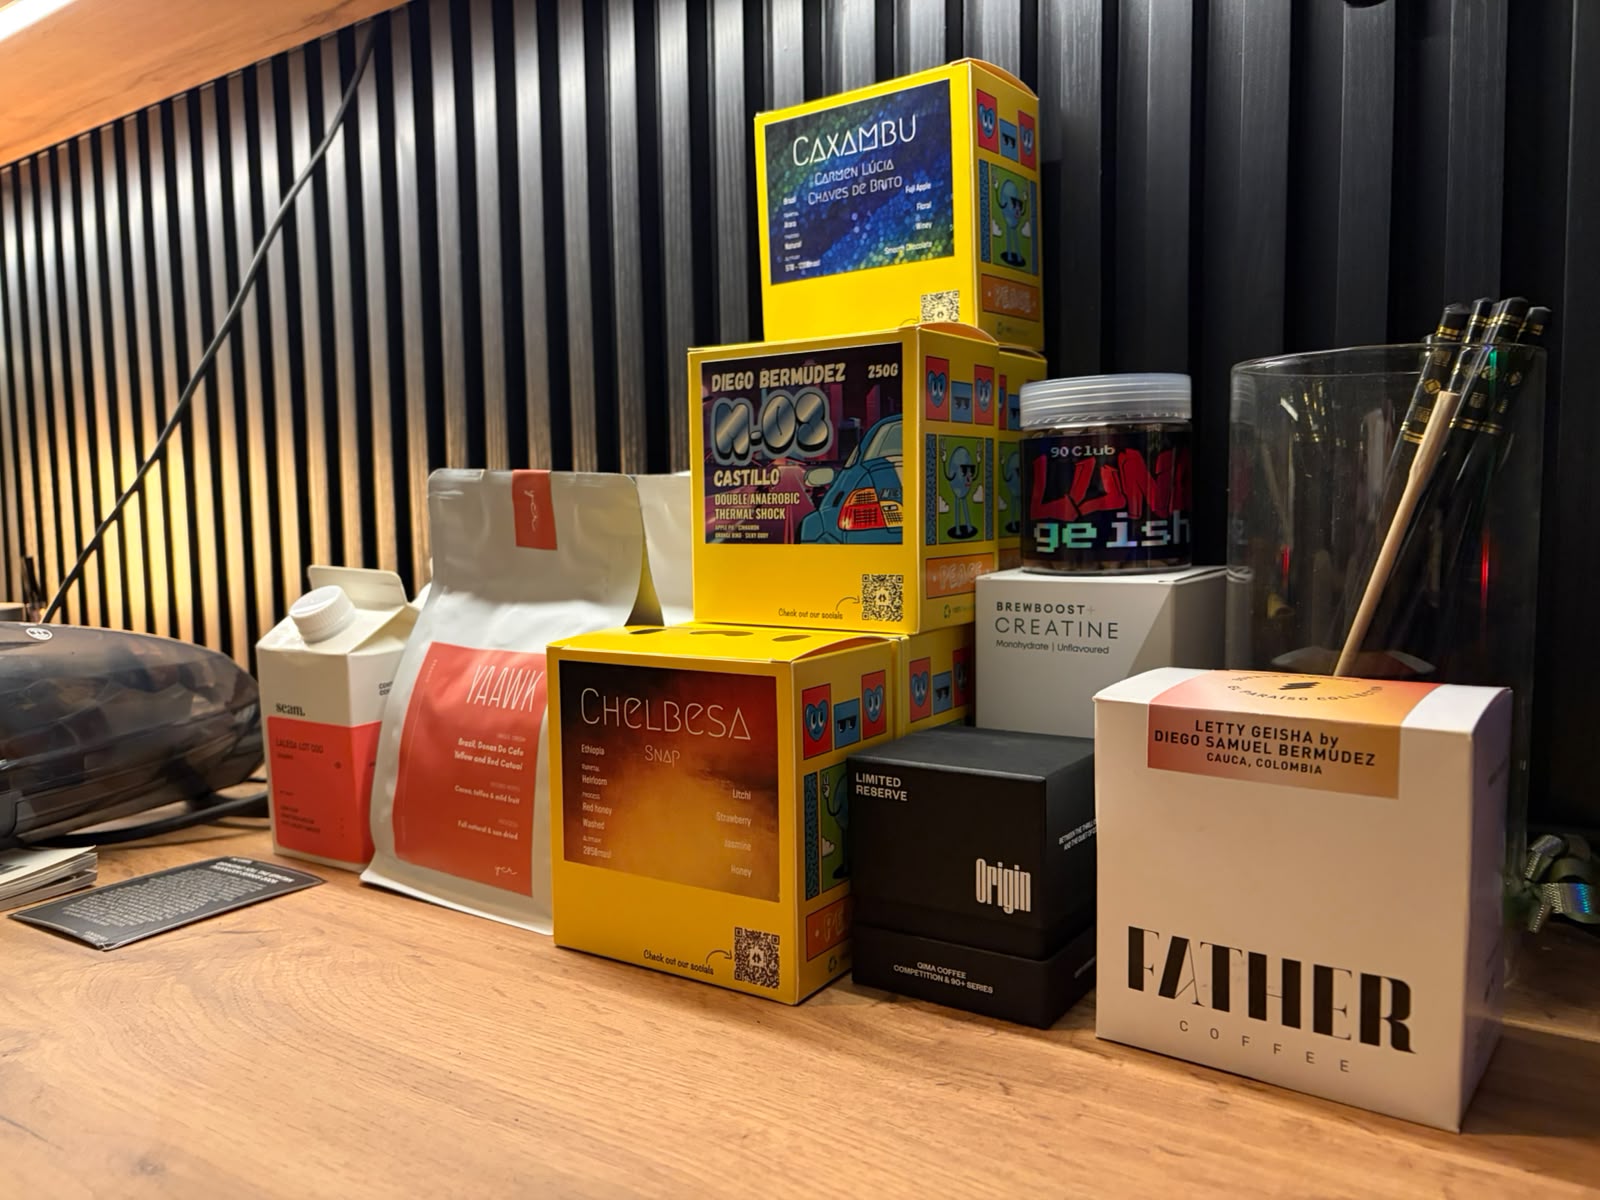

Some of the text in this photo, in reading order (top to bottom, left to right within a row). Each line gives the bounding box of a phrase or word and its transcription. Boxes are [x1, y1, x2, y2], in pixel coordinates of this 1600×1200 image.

[792, 113, 917, 167] CAXAMBU
[869, 175, 903, 193] BRITO
[711, 362, 846, 392] DIEGO BERMUDEZ
[868, 363, 899, 379] 250G
[1051, 445, 1116, 458] 90 Club
[713, 468, 780, 487] CASTILLO
[714, 492, 800, 506] DOUBLE ANAEROBIC
[714, 507, 785, 520] THERMAL SHOCK
[778, 607, 843, 620] Check out our socials
[995, 616, 1119, 640] CREATINE
[996, 640, 1049, 651] Monohydrate
[1057, 643, 1109, 655] Unflavoured
[465, 665, 544, 713] YAAWK
[276, 702, 306, 717] seam.
[1154, 729, 1200, 746] DIEGO
[1205, 735, 1272, 755] SAMUEL
[1195, 719, 1339, 749] LETTY GEISHA by
[581, 743, 605, 756] Ethiopia
[474, 755, 486, 764] and
[1206, 752, 1322, 775] CAUCA, COLOMBIA
[582, 774, 608, 786] Heirloom
[855, 771, 902, 788] LIMITED
[855, 784, 908, 802] RESERVE
[582, 802, 612, 817] Red honey
[582, 818, 605, 830] Washed
[716, 811, 752, 828] Strawberry
[730, 863, 752, 879] Honey
[975, 857, 1032, 915] Origin
[643, 948, 714, 976] Check out our socials
[916, 962, 967, 980] QIMA COFFEE
[893, 964, 944, 983] COMPETITION
[966, 981, 994, 994] SERIES
[1127, 925, 1417, 1055] FATHER
[1178, 1019, 1350, 1073] COFFEE
